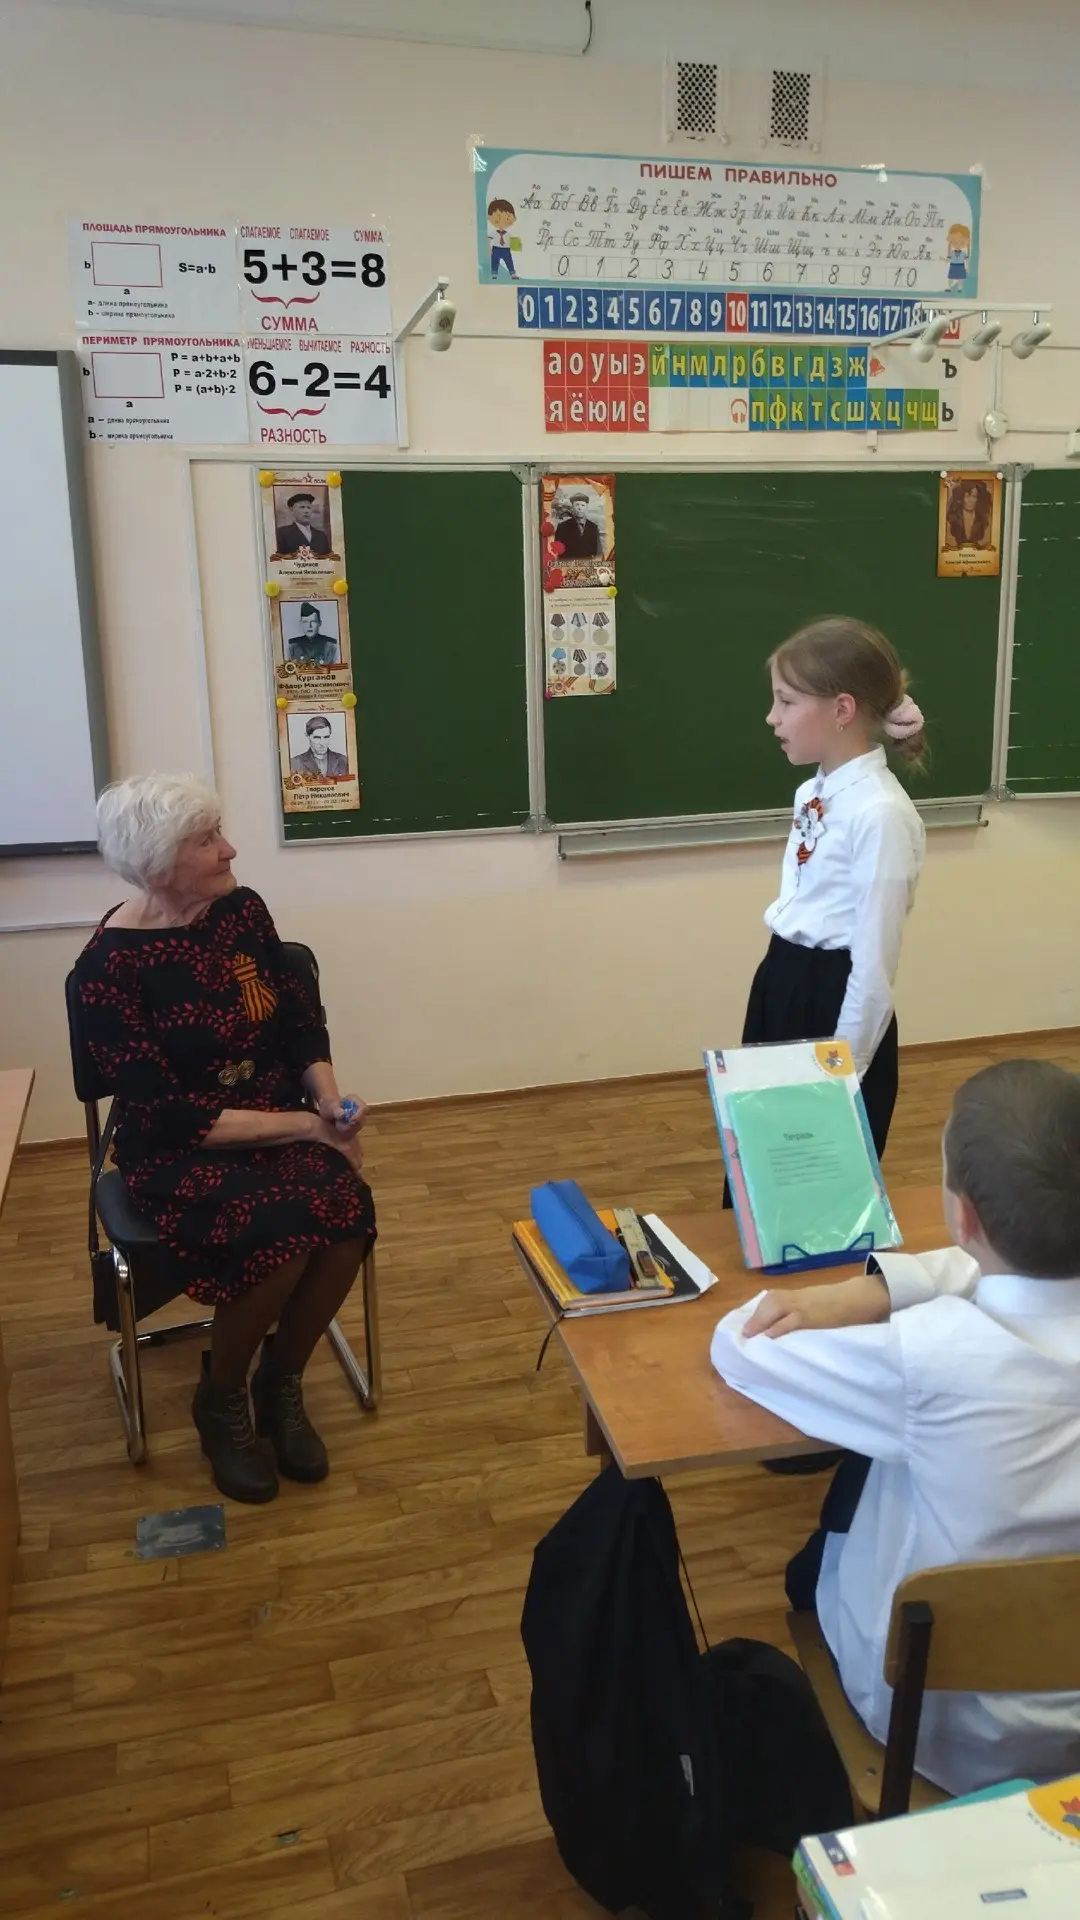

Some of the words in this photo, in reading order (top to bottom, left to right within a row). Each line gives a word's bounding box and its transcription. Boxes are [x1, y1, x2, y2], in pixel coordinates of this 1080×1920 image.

[640, 163, 712, 181] ПИШЕМ
[725, 168, 837, 188] ПРАВИЛЬНО
[550, 192, 576, 211] Бб
[579, 194, 599, 212] Вв
[694, 200, 726, 218] Жж
[82, 223, 133, 234] ПЛОЩАДЬ
[135, 225, 227, 237] ПРЯМОУГОЛЬНИКА
[240, 226, 281, 239] СЛАГАЕМОЕ
[290, 228, 330, 241] СЛАГАЕМОЕ
[354, 230, 383, 243] СУММА
[84, 261, 91, 269] b
[557, 255, 569, 276] 0
[596, 256, 605, 277] 1
[627, 257, 640, 279] 2
[661, 259, 674, 279] 3
[698, 260, 708, 280] 4
[728, 261, 741, 281] 5
[762, 262, 774, 282] 6
[796, 263, 807, 283] 7
[828, 264, 840, 285] 8
[860, 265, 871, 286] 9
[522, 295, 535, 323] 0
[544, 295, 555, 323] 1
[565, 295, 578, 323] 2
[586, 296, 598, 324] 3
[606, 297, 620, 324] 4
[628, 297, 640, 325] 5
[649, 298, 661, 326] 6
[669, 298, 682, 325] 7
[690, 299, 702, 326] 8
[710, 299, 722, 327] 9
[728, 300, 747, 327] 10
[751, 301, 768, 327] 11
[773, 301, 792, 327] 12
[795, 302, 813, 328] 13
[816, 303, 835, 330] 14
[838, 304, 856, 331] 15
[860, 305, 879, 331] 16
[882, 305, 901, 331] 17
[903, 304, 921, 328] 18
[261, 316, 319, 332] СУММА
[82, 336, 138, 346] ПЕРИМЕТР
[143, 337, 241, 347] ПРЯМОУГОЛЬНИКА
[299, 340, 341, 353] ВЫЧИТАЕМОЕ
[350, 341, 391, 354] РАЗНОСТЬ
[82, 367, 90, 376] b
[548, 352, 562, 375] а
[569, 352, 584, 375] о
[591, 353, 605, 383] у
[610, 353, 628, 375] ы
[633, 353, 646, 375] э
[652, 346, 666, 376] й
[673, 355, 686, 376] н
[690, 355, 708, 376] м
[712, 355, 727, 377] л
[732, 355, 746, 384] р
[751, 348, 766, 378] б
[772, 356, 785, 377] в
[793, 356, 803, 377] г
[809, 356, 826, 383] д
[831, 357, 842, 378] з
[848, 357, 866, 377] ж
[549, 400, 563, 422] я
[570, 393, 583, 422] ё
[589, 401, 607, 423] ю
[612, 401, 626, 422] и
[633, 400, 646, 422] е
[751, 401, 764, 423] п
[769, 394, 787, 430] ф
[791, 401, 804, 422] к
[811, 401, 823, 422] т
[830, 401, 841, 422] с
[847, 401, 865, 422] ш
[869, 401, 881, 421] х
[887, 401, 901, 427] ц
[906, 401, 918, 421] ч
[921, 401, 937, 427] щ
[260, 428, 327, 443] РАЗНОСТЬ
[296, 674, 336, 682] Курганов
